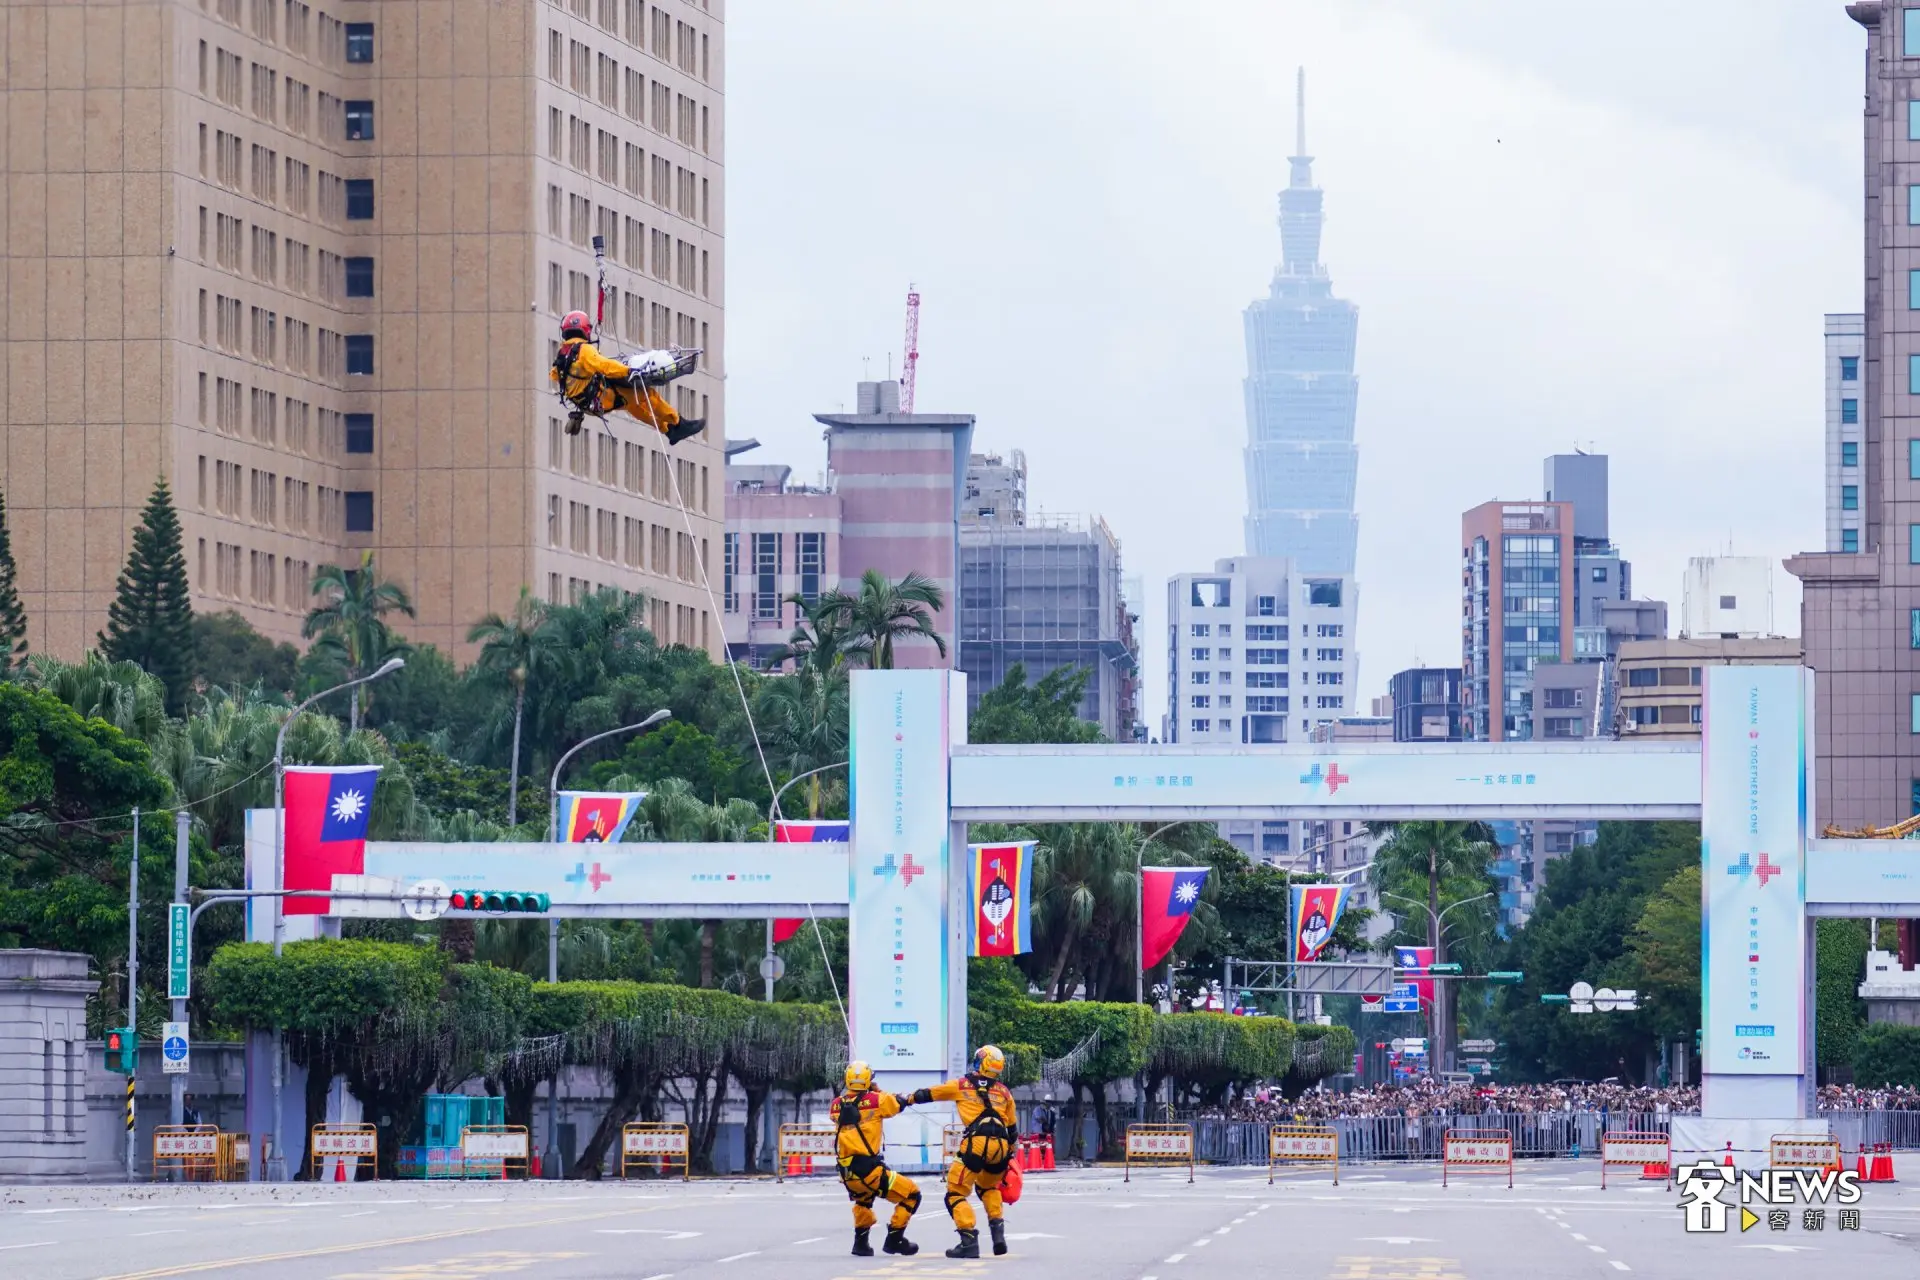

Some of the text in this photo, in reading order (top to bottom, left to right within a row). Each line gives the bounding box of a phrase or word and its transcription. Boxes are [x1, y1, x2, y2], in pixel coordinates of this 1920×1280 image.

[894, 689, 903, 728] TAIWAN
[1750, 687, 1759, 725] TAIWAN
[894, 748, 903, 798] TOGETHER
[1750, 745, 1759, 796] TOGETHER
[1114, 775, 1193, 787] 慶祝華民國
[1455, 774, 1536, 785] 一一五年國慶
[1750, 813, 1759, 834] ONE
[160, 1139, 213, 1150] 車輛改道
[1133, 1138, 1187, 1150] 車輛改道
[1277, 1140, 1331, 1151] 車輛改道
[1777, 1149, 1833, 1160] 車輛改道
